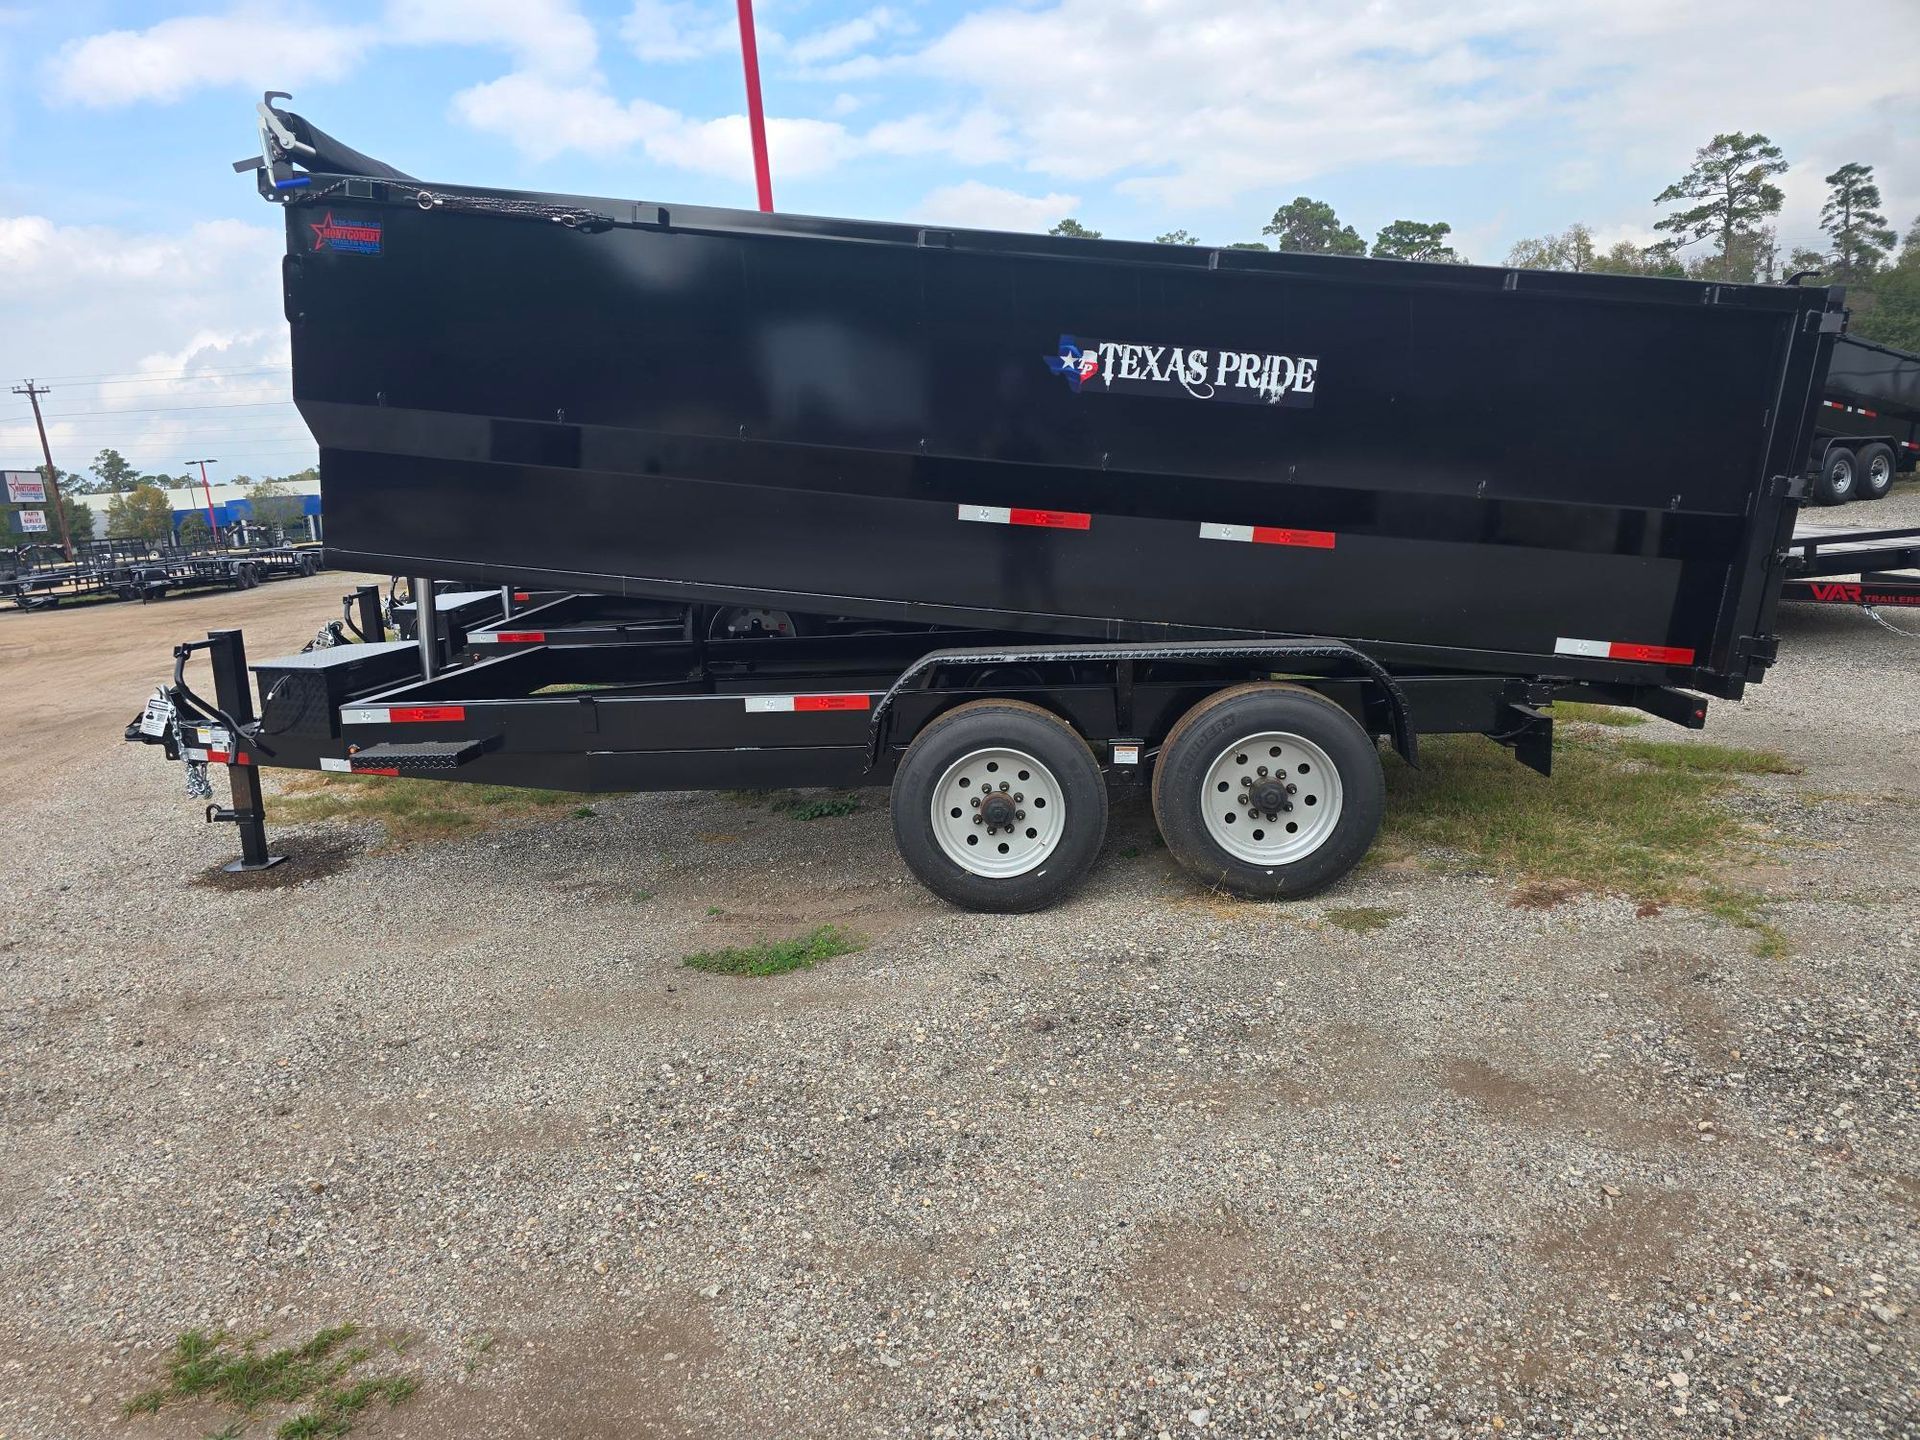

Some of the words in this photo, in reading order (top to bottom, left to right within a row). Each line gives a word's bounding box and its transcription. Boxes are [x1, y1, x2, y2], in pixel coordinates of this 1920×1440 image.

[322, 228, 381, 242] MONTGOMERY
[1099, 343, 1214, 399] TEXAS
[1215, 351, 1318, 404] PRIDE
[1809, 583, 1863, 601] VAR
